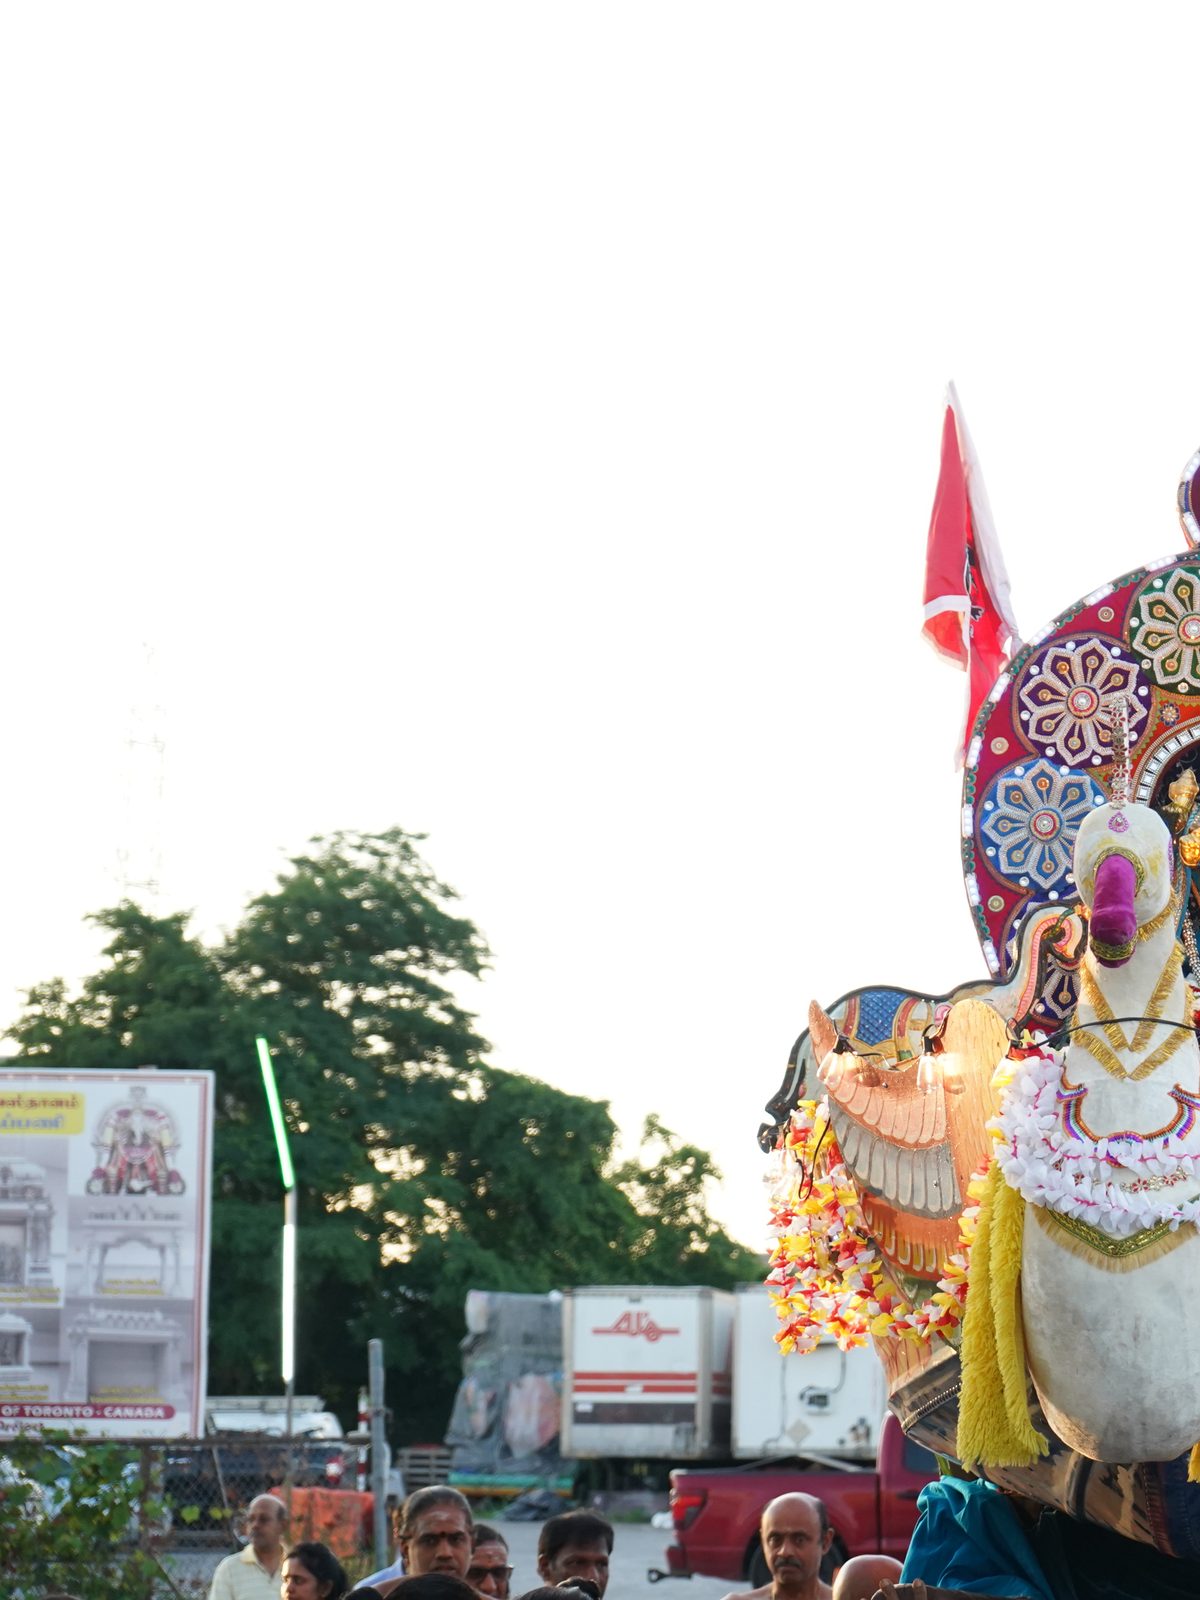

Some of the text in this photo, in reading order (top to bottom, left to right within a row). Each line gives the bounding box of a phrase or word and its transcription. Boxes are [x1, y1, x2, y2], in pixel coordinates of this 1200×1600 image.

[1, 1405, 165, 1418] OF TORONTO CANADA
